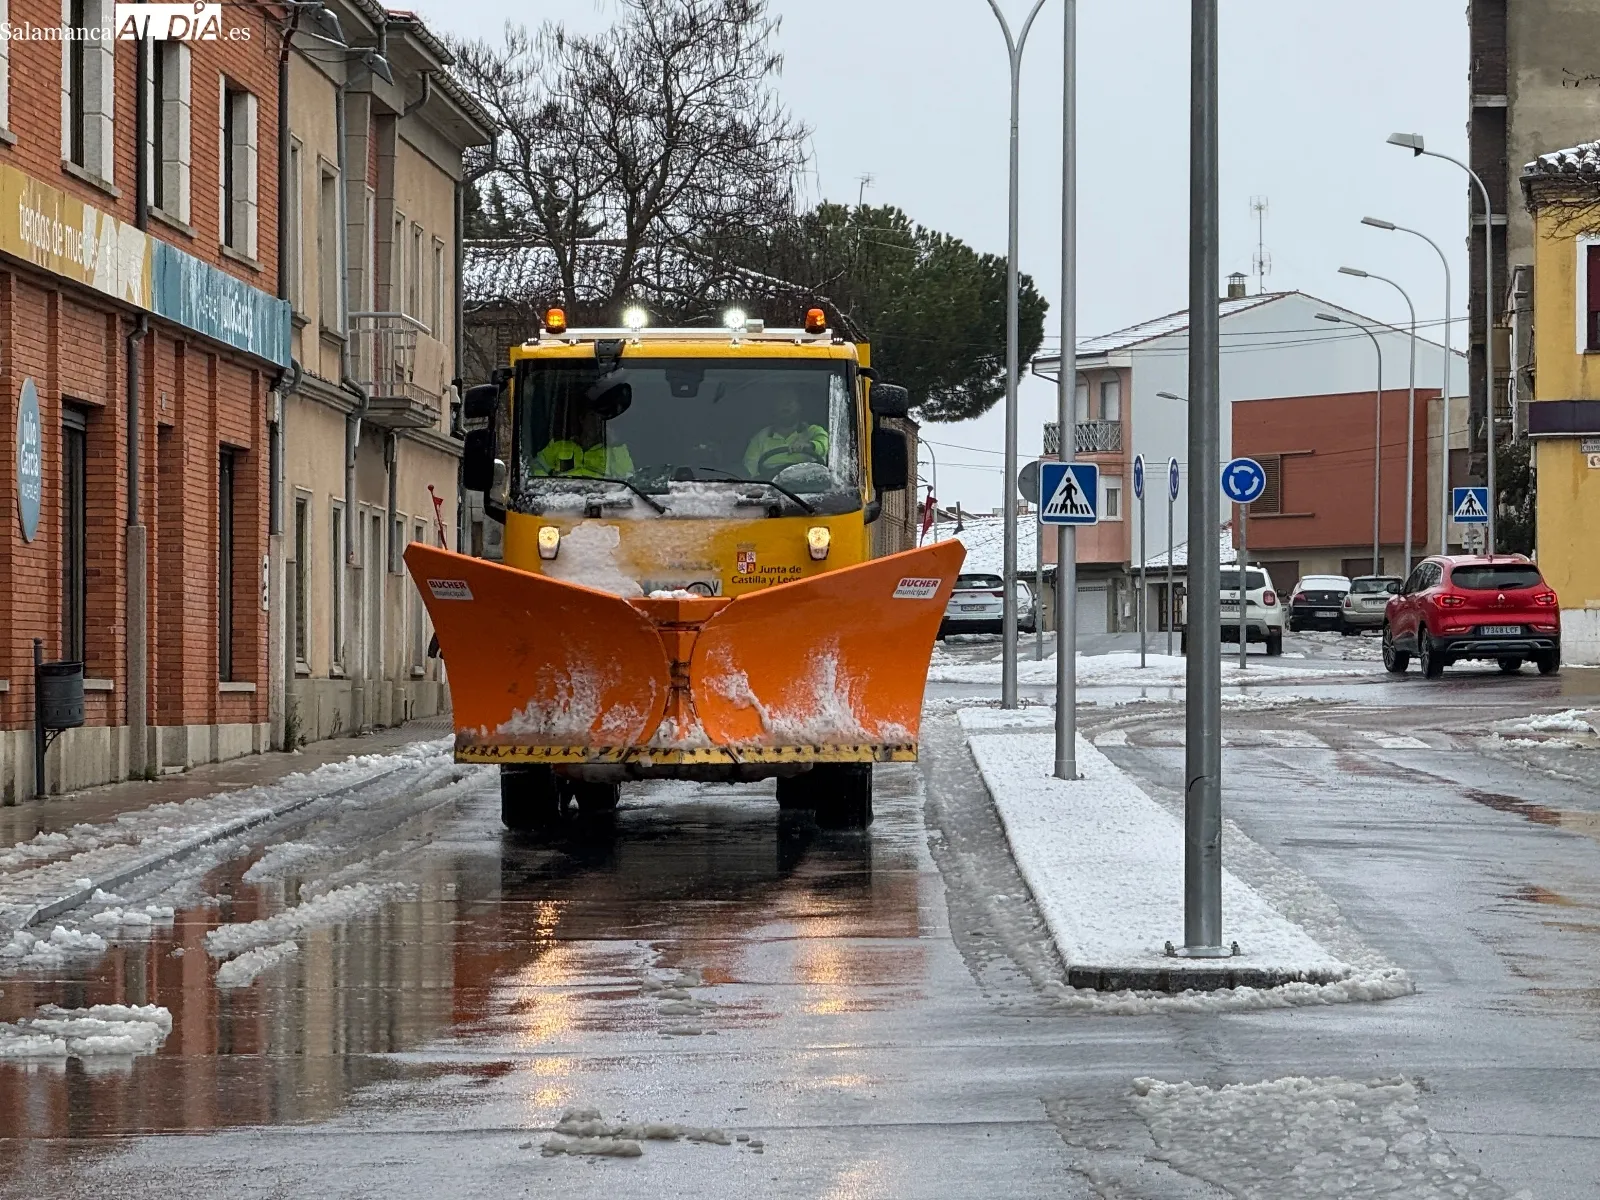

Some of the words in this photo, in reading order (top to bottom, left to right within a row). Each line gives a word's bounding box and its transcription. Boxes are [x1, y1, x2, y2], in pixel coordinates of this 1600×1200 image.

[52, 202, 63, 257] de
[758, 565, 786, 574] Junta
[789, 565, 802, 574] de
[429, 580, 467, 589] BUCHER
[731, 575, 766, 584] Castilla
[769, 577, 775, 586] y
[899, 579, 939, 588] BUCHER
[896, 588, 930, 597] municipal
